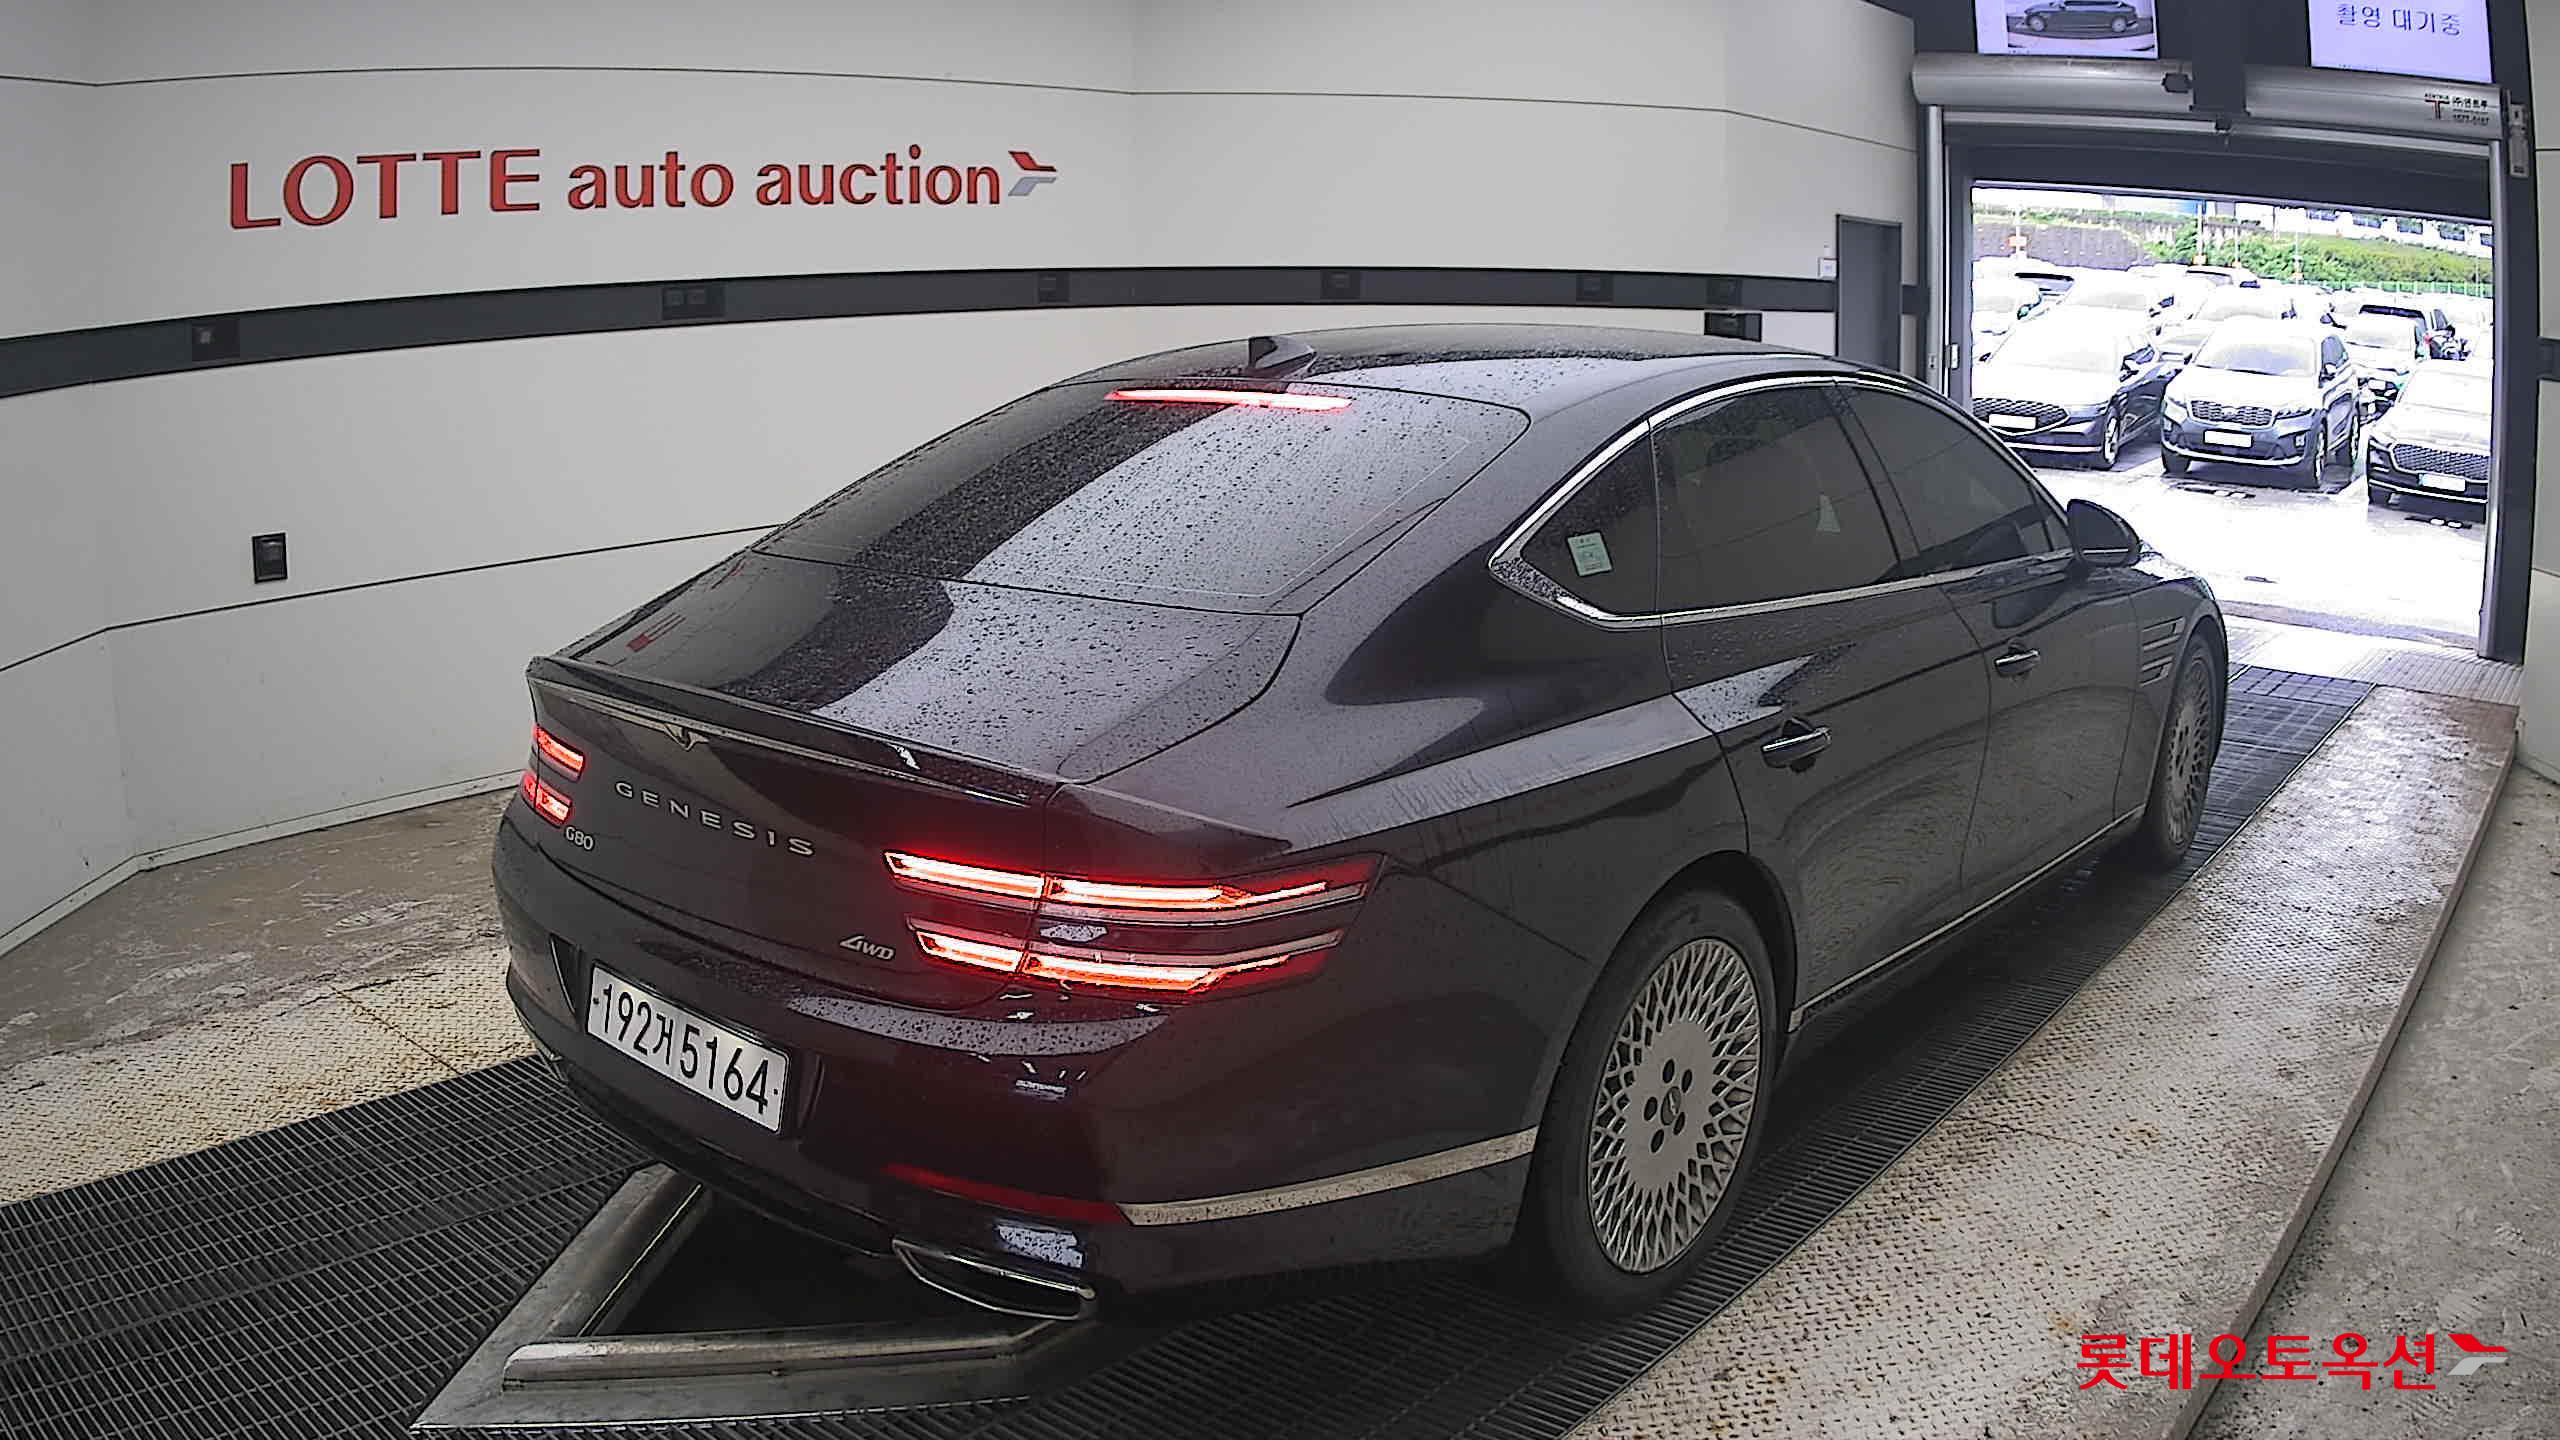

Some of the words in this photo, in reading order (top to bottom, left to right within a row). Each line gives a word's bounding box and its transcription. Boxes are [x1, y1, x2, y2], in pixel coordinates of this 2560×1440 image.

[2337, 4, 2381, 28] 촬영
[2392, 8, 2461, 37] 대기중
[230, 148, 541, 230] LOTTE
[567, 150, 735, 209] auto
[755, 143, 1001, 206] auction
[615, 781, 814, 857] GENESIS
[565, 825, 594, 851] G80
[839, 935, 895, 960] 4WD
